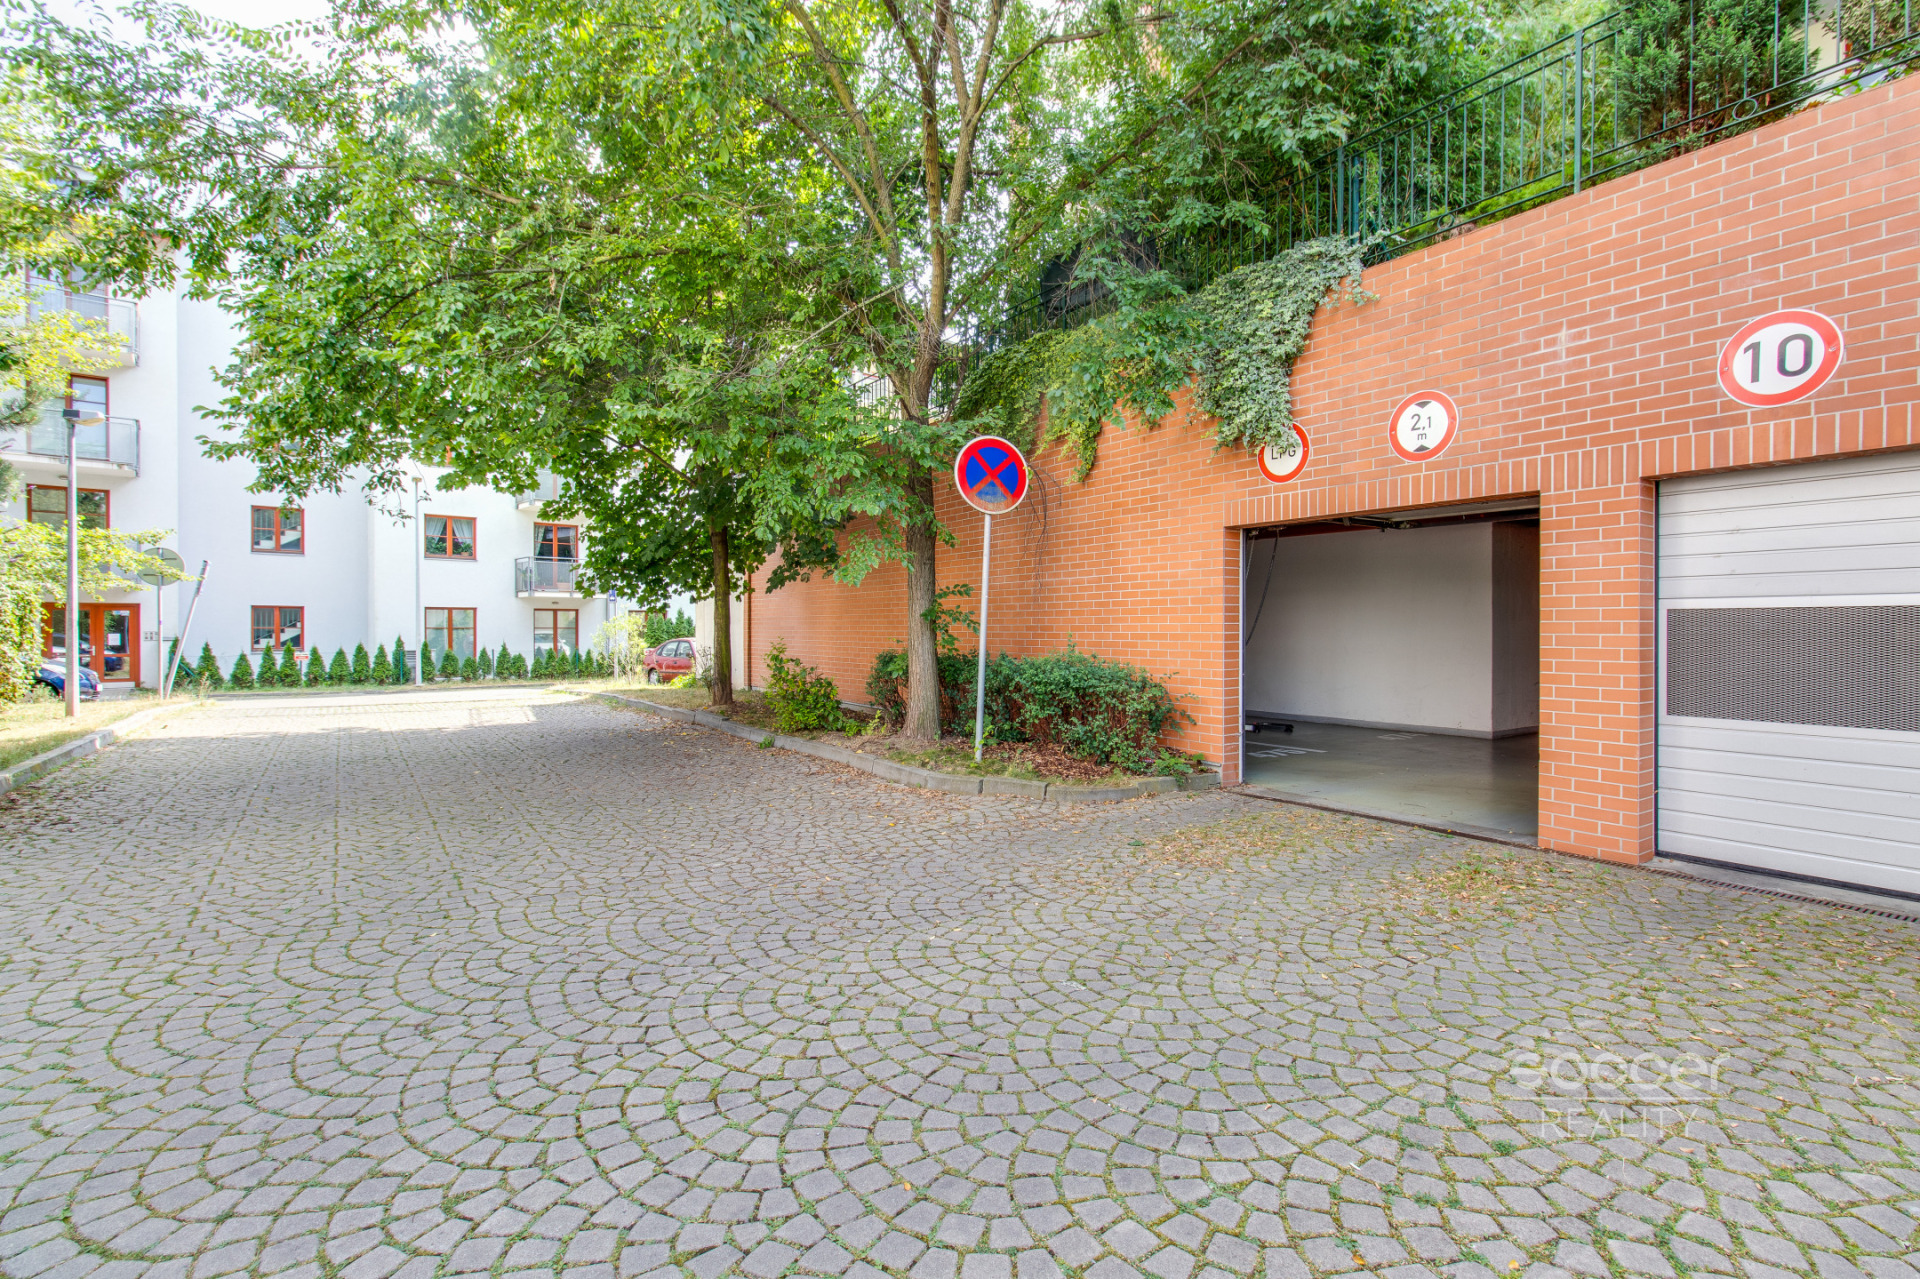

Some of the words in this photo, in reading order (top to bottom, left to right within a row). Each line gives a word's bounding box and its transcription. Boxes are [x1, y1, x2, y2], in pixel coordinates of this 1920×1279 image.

[1743, 333, 1813, 383] 10
[1410, 413, 1432, 431] 2,1
[1417, 432, 1427, 441] m
[1271, 445, 1296, 460] LPG
